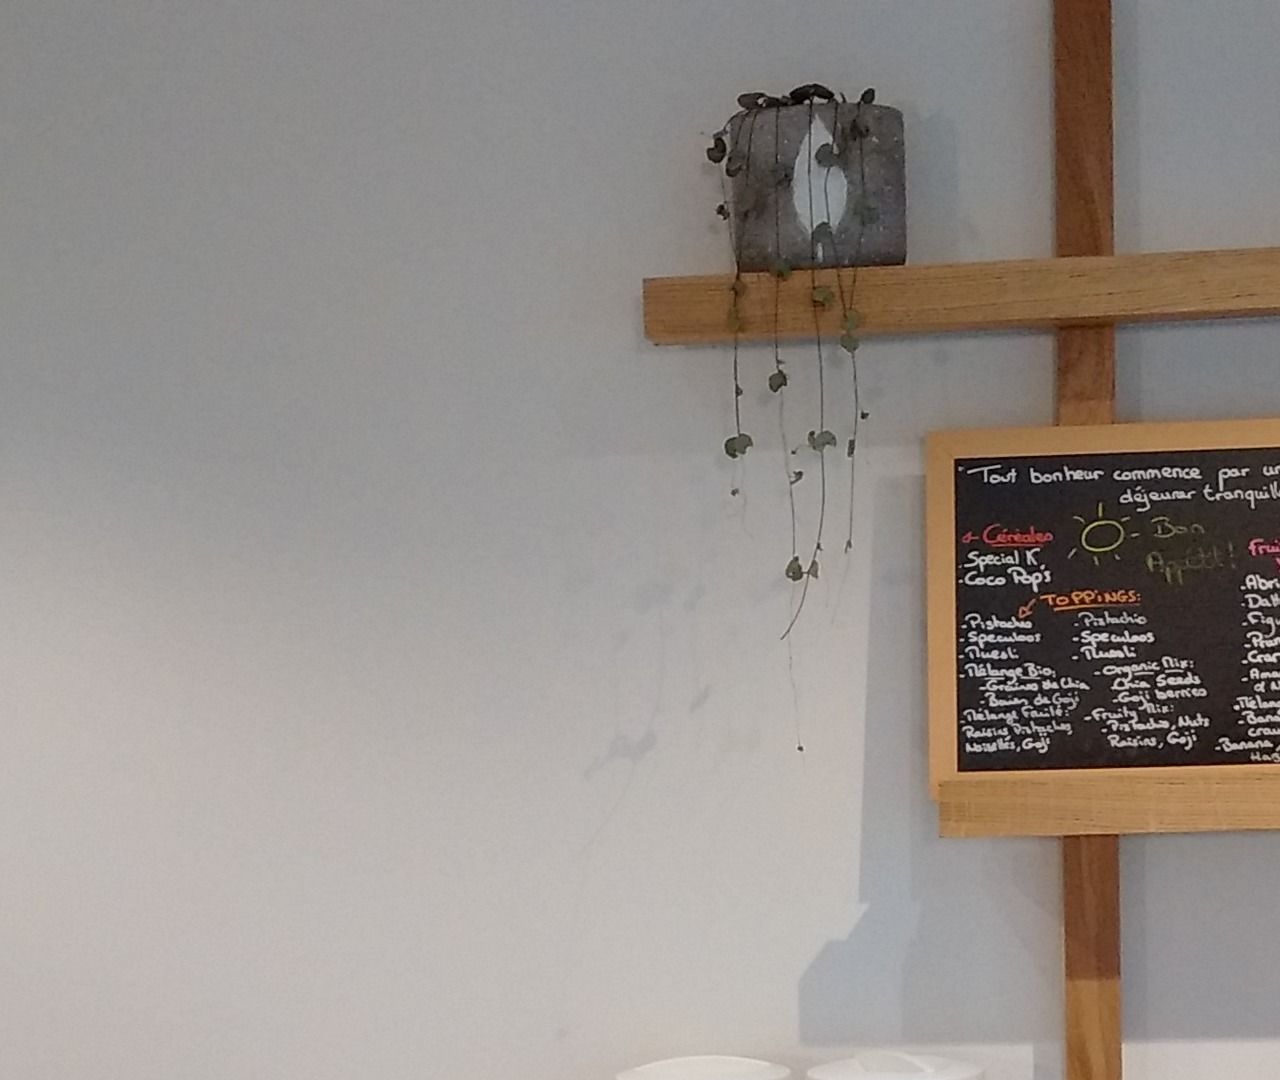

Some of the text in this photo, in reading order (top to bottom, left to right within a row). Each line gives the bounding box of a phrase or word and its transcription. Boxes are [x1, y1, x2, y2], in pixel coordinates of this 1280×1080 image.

[1029, 466, 1105, 484] bonheur
[1113, 466, 1203, 481] commence
[1218, 467, 1251, 492] par
[1119, 485, 1197, 512] déjeuner
[1150, 516, 1206, 538] Bon
[964, 548, 1041, 573] Special K
[964, 571, 1007, 586] Coco
[967, 631, 1041, 649] Speculoos
[1080, 630, 1156, 648] Speculoos
[1060, 677, 1091, 691] Chia
[1155, 671, 1201, 687] Seeds
[1051, 690, 1080, 710] Goji
[1117, 690, 1151, 711] Goji
[1091, 706, 1139, 725] Fruity
[1178, 712, 1210, 728] Nuts
[1022, 732, 1051, 754] Goji
[1166, 729, 1198, 751] Goji
